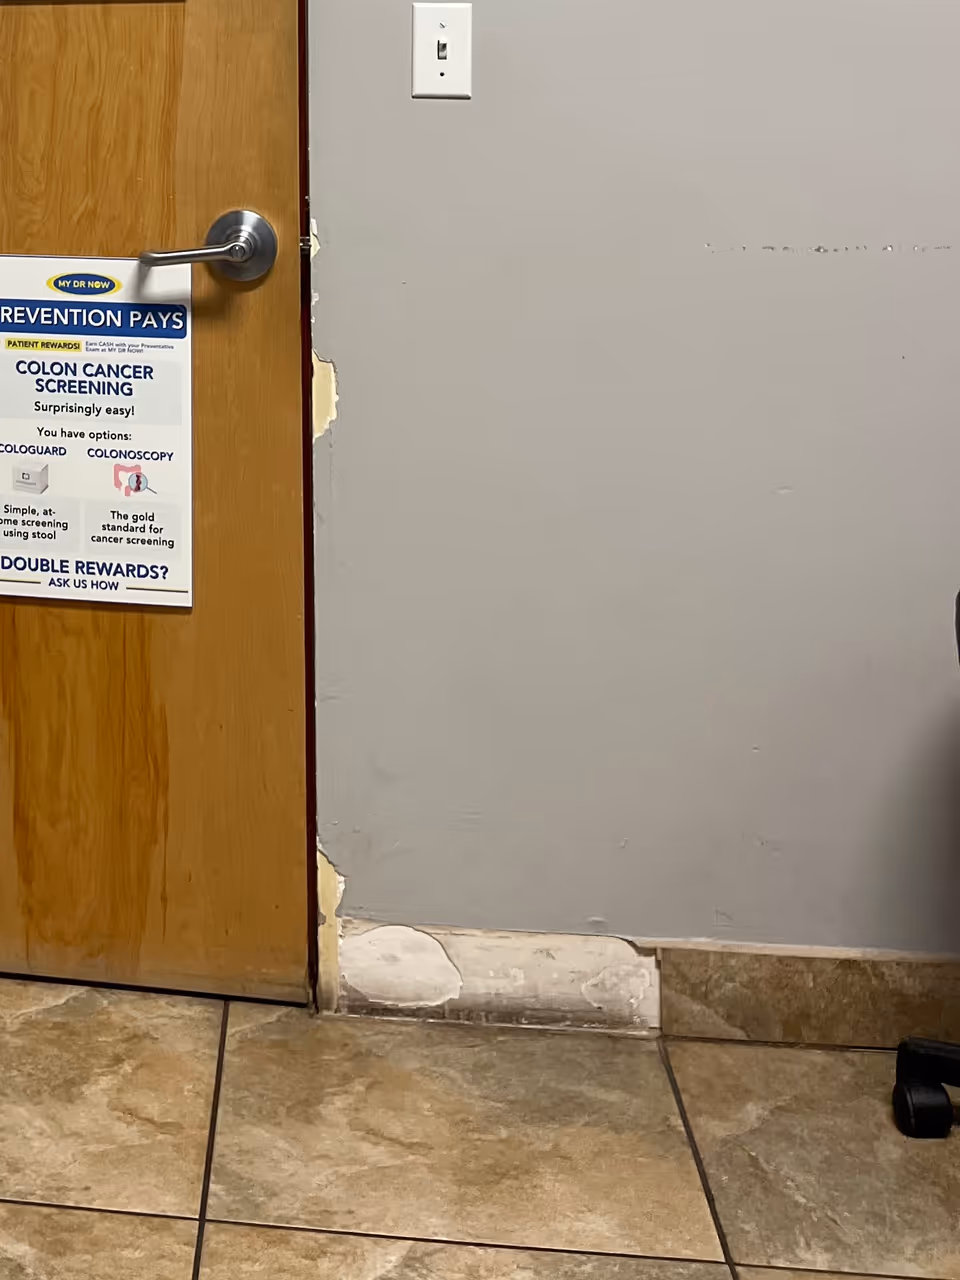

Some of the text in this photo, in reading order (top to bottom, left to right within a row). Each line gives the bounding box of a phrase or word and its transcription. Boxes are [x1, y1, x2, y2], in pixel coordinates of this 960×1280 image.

[73, 280, 85, 288] DR
[88, 280, 110, 288] NOW
[130, 312, 184, 329] PAYS
[41, 342, 80, 350] REWARDS!
[16, 360, 153, 379] COLON CANCER
[36, 379, 133, 396] SCREENING
[34, 401, 134, 418] Surprisingly easy!
[37, 427, 132, 441] You have options:
[87, 448, 174, 461] COLONOSCOPY
[4, 505, 55, 516] Simple, at-
[110, 511, 154, 523] The gold
[21, 518, 68, 530] screening
[102, 522, 163, 534] standard for
[3, 529, 56, 540] using stool
[91, 534, 174, 548] cancer screening
[1, 556, 168, 580] DOUBLE REWARDS?
[49, 578, 119, 590] ASK US HOW
